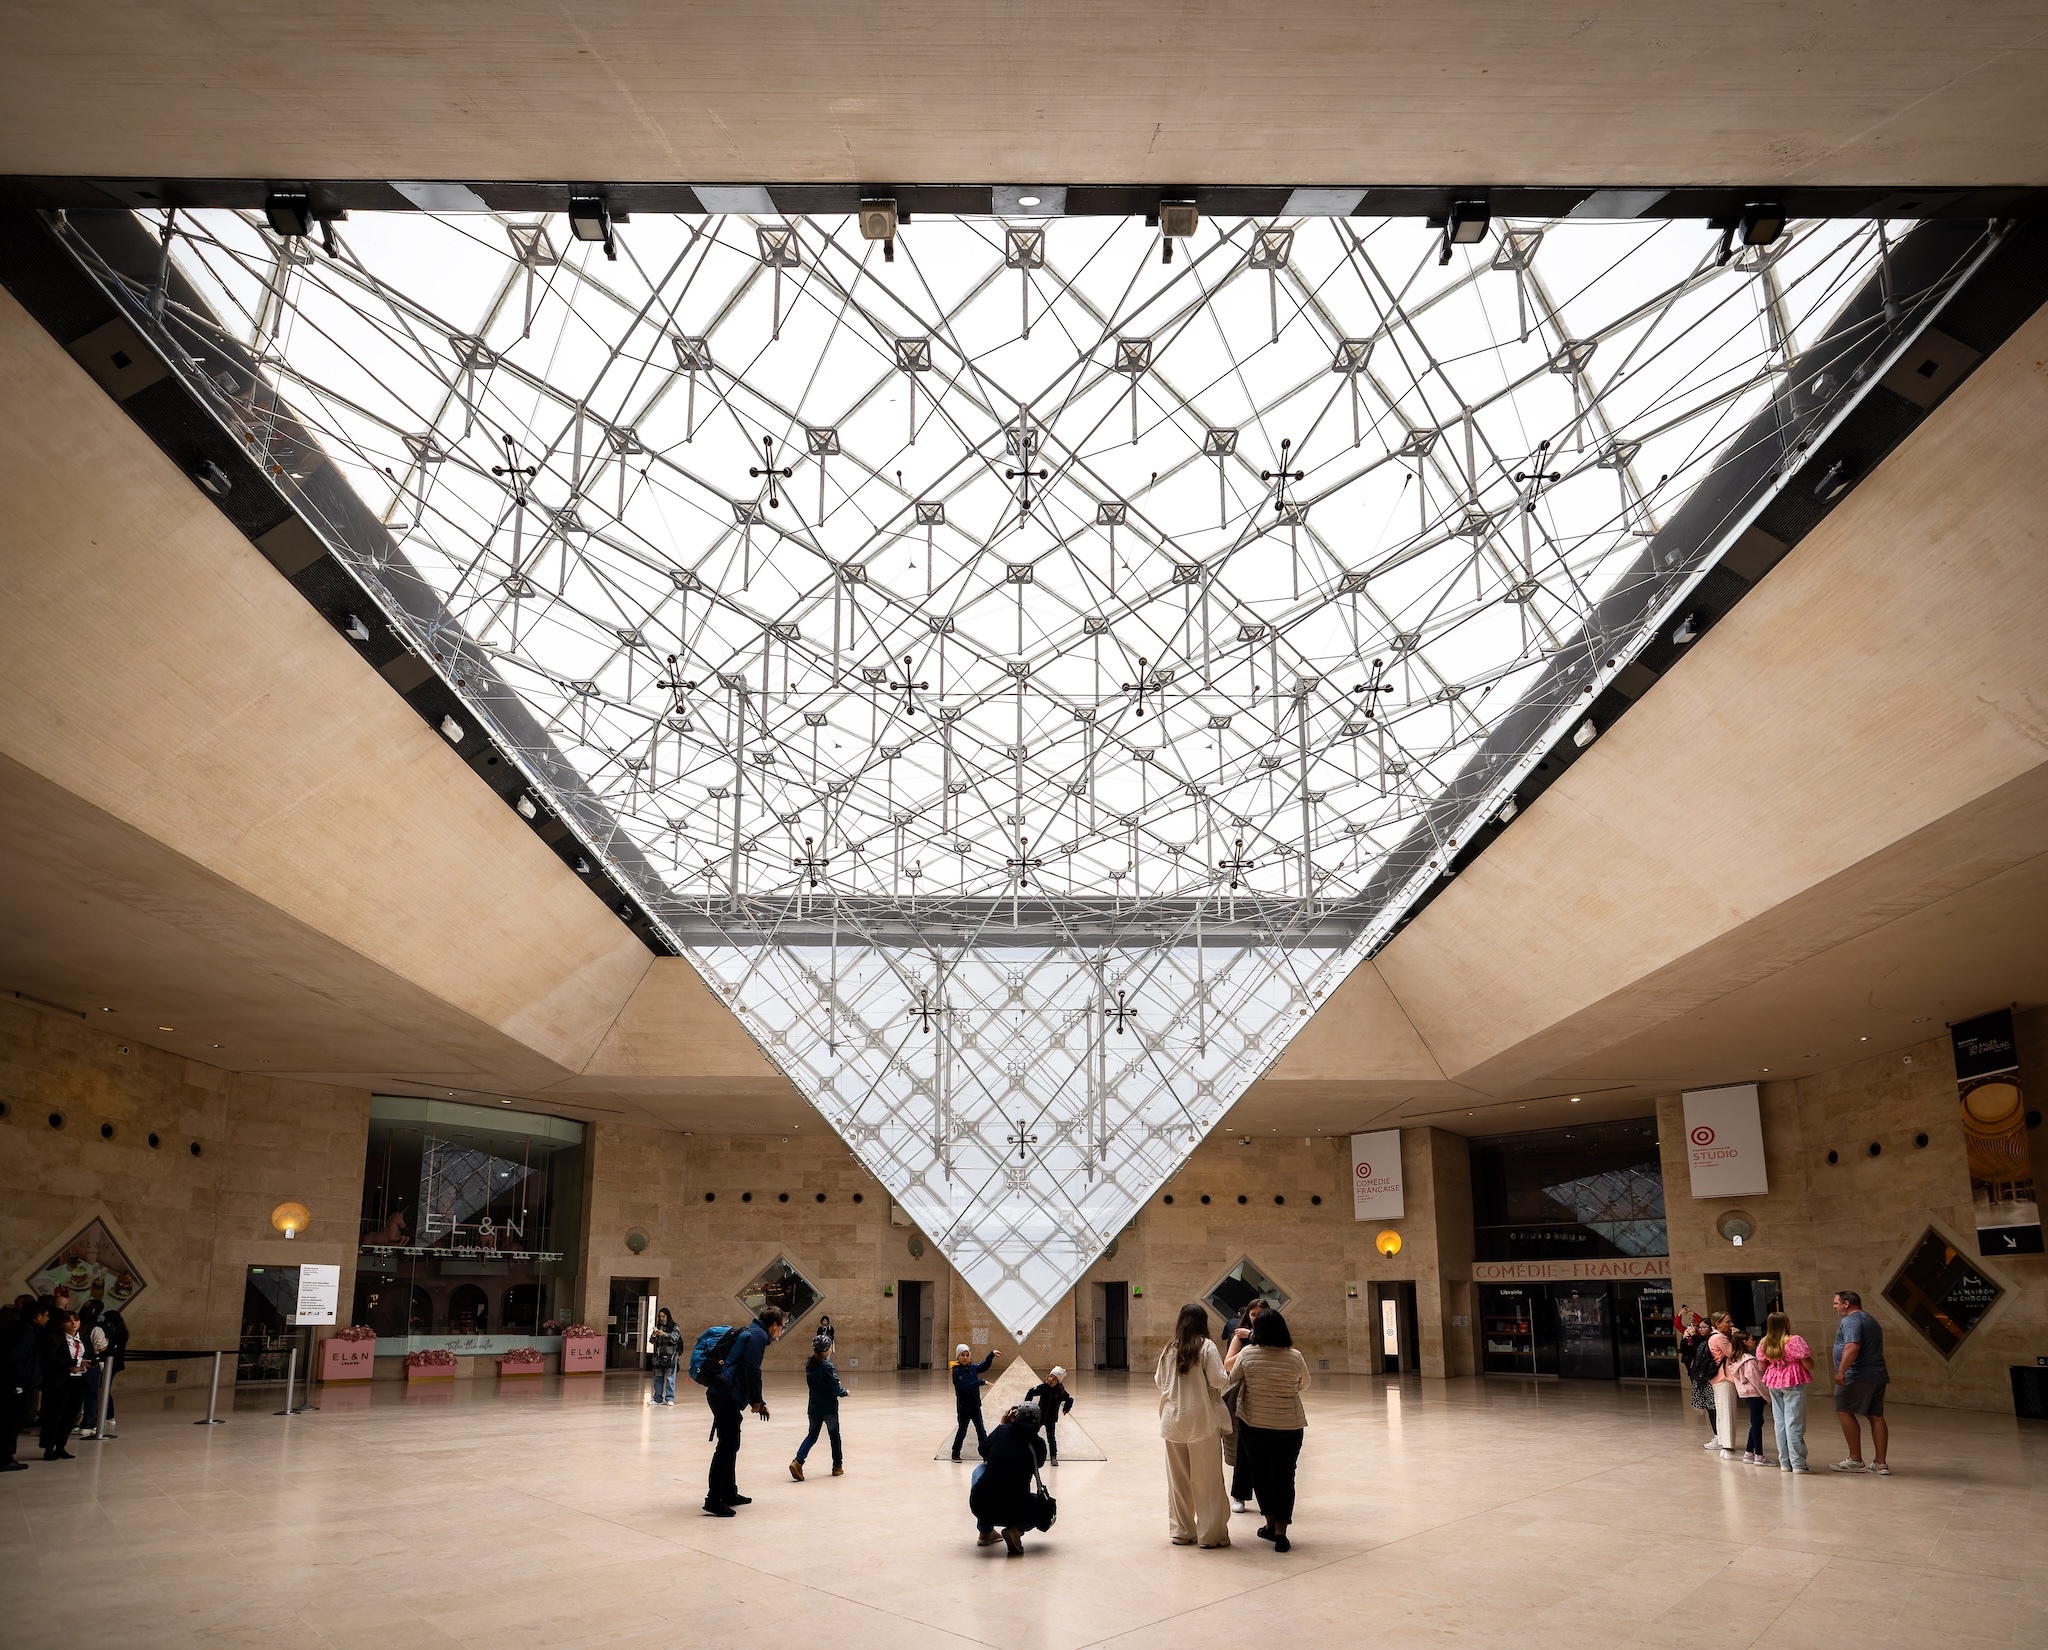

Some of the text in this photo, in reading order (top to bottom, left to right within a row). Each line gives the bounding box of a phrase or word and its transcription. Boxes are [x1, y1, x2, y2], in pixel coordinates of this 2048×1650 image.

[1693, 1149, 1738, 1160] STUDIO
[1356, 1177, 1390, 1187] COMÉDIE
[1356, 1184, 1400, 1194] FRANÇAISE
